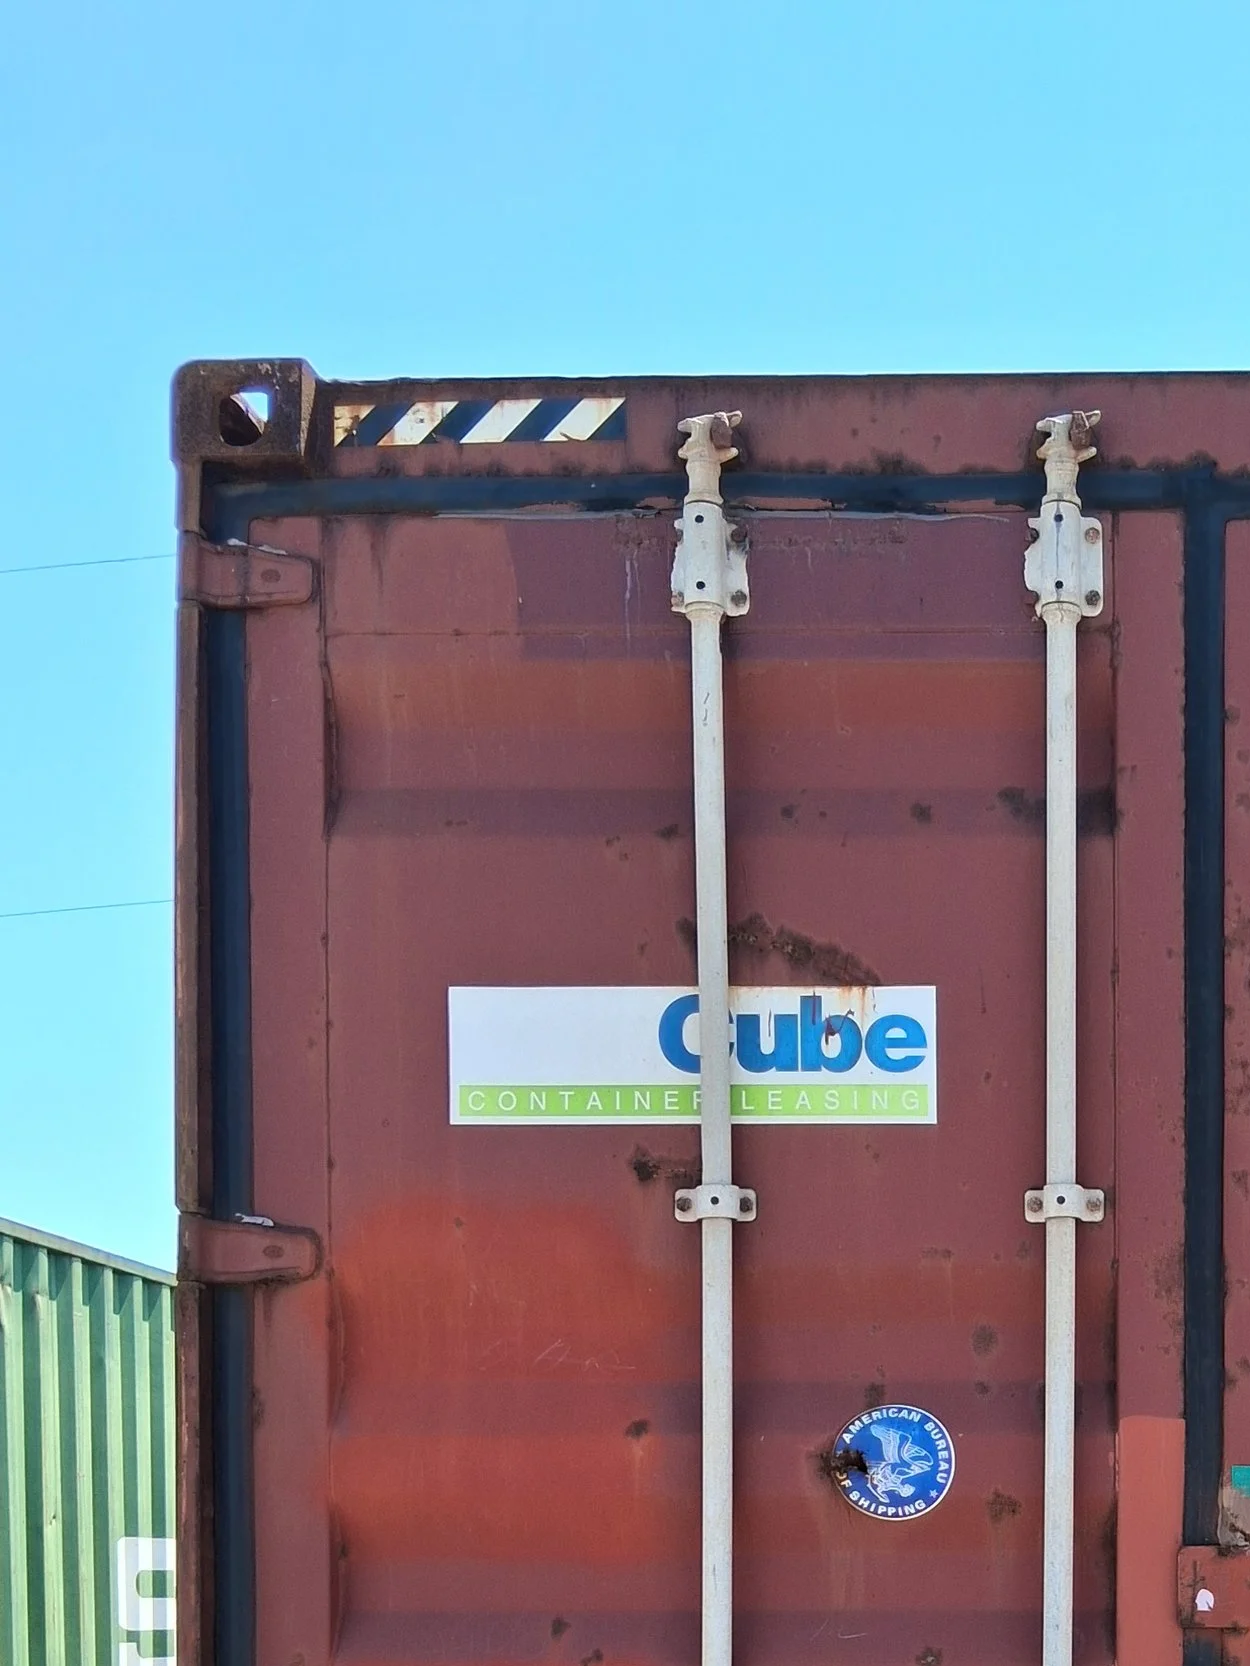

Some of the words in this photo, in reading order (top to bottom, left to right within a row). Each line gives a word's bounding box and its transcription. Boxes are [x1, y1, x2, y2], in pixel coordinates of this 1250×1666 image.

[658, 993, 928, 1074] Cube
[741, 1090, 921, 1111] LEASING
[841, 1408, 922, 1444] AMERICAN
[924, 1421, 948, 1484] BUREAU
[849, 1490, 927, 1517] SHIPPING
